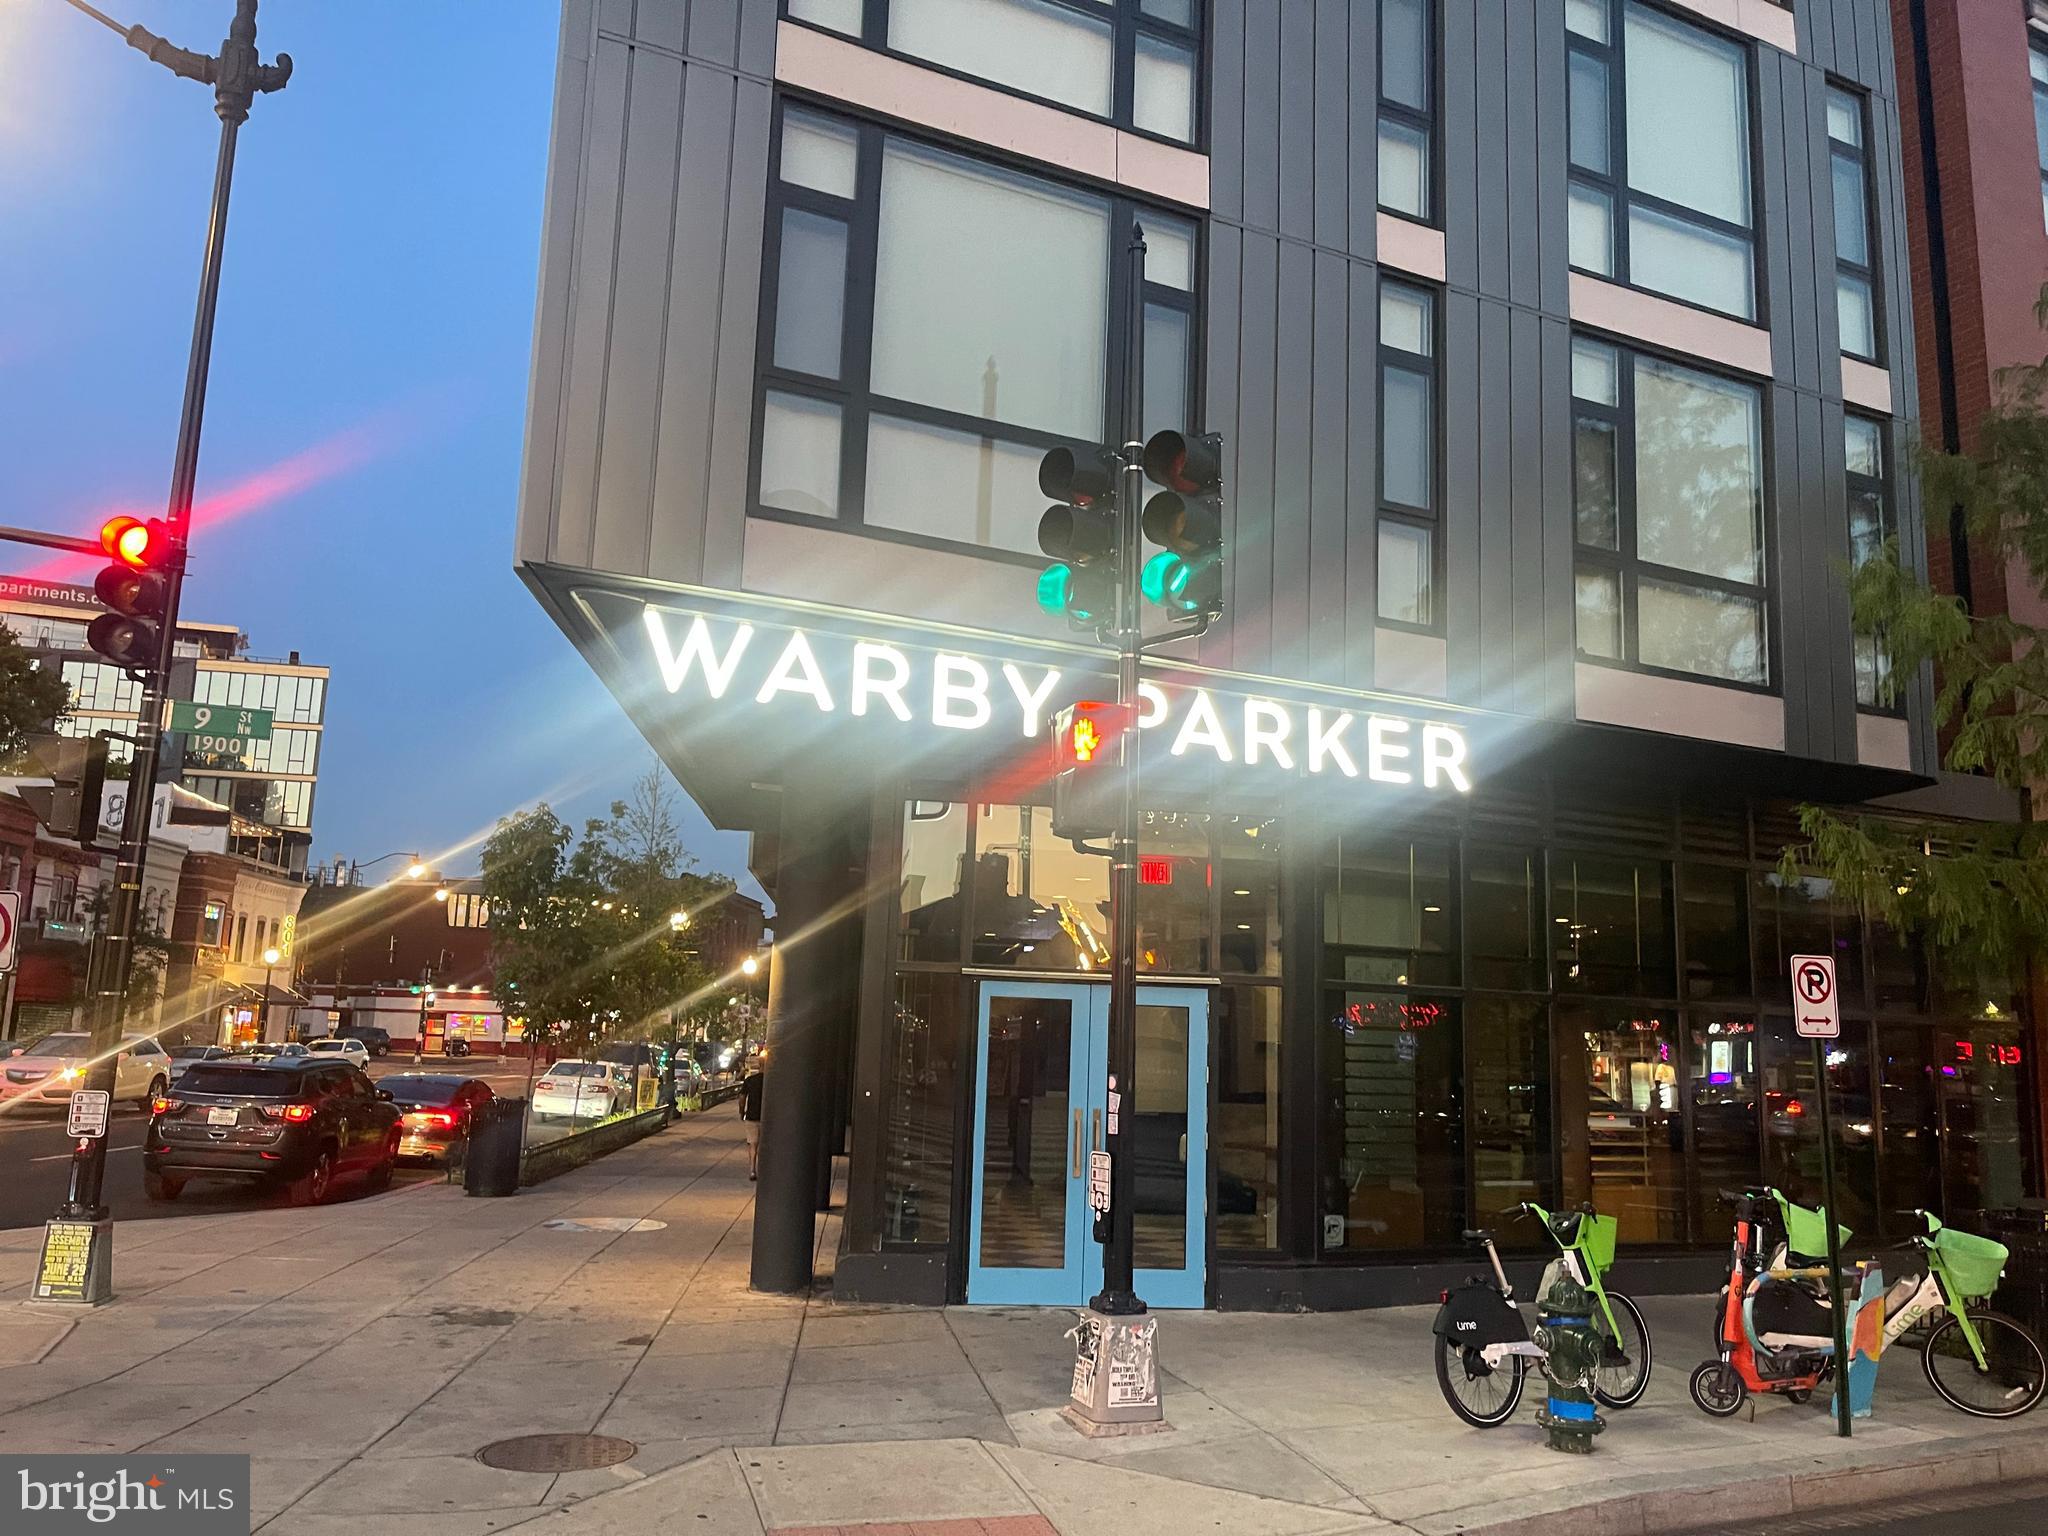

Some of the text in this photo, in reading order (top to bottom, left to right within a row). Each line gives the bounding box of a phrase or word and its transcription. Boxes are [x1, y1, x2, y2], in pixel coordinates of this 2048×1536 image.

[0, 582, 106, 606] partments.c
[643, 609, 1062, 738] WARBY
[193, 707, 252, 730] 9 St
[193, 735, 241, 754] 1900
[48, 1234, 92, 1246] ASSEMBLY
[43, 1262, 87, 1277] JUNE 29
